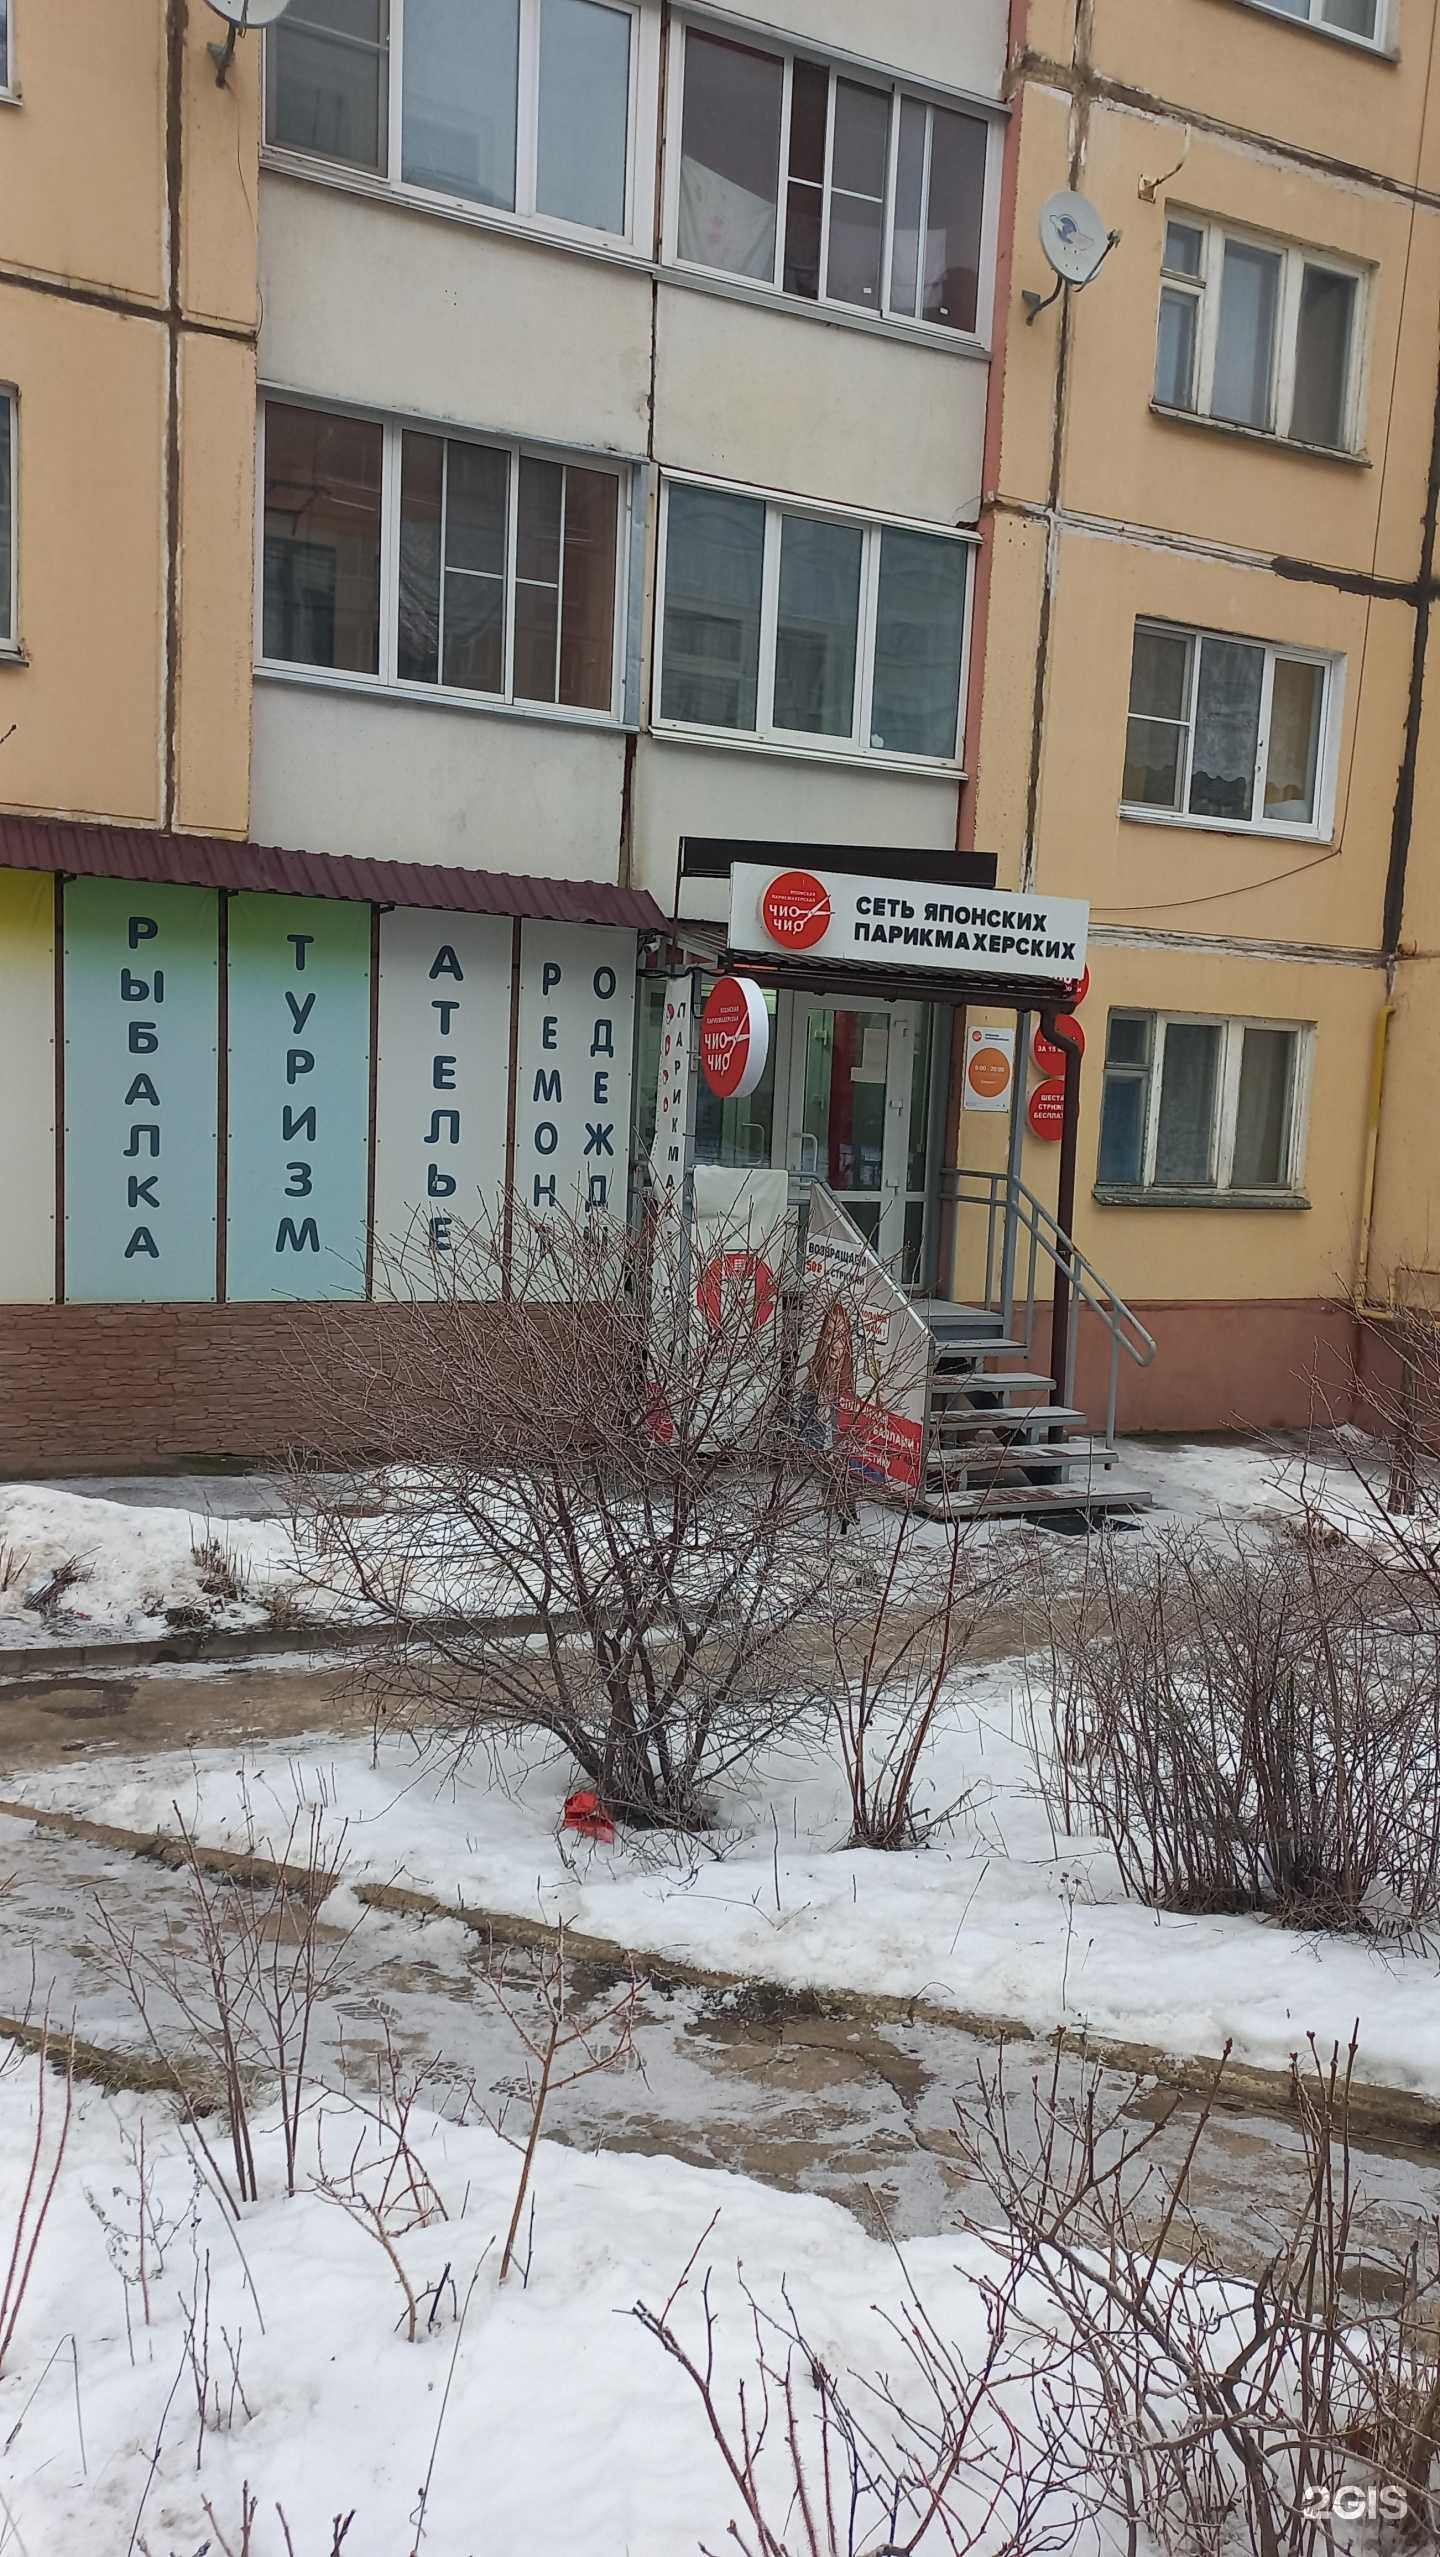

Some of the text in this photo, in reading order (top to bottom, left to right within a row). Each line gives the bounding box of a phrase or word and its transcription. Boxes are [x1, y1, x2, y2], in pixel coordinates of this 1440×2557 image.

[769, 904, 800, 917] ЧИО
[773, 918, 804, 934] ЧИО
[856, 896, 1048, 933] СЕТЬ ЯПОНСКИХ
[854, 922, 1076, 960] ПАРИКМАХЕРСКИХ
[704, 1031, 728, 1049] ЧИО
[707, 1053, 730, 1073] ЧИО
[120, 916, 164, 1259] РЫБАЛКА
[275, 934, 320, 1253] ТУРИЗМ
[423, 945, 464, 1251] АТЕЛЬЕ
[532, 962, 562, 1256] РЕМОН
